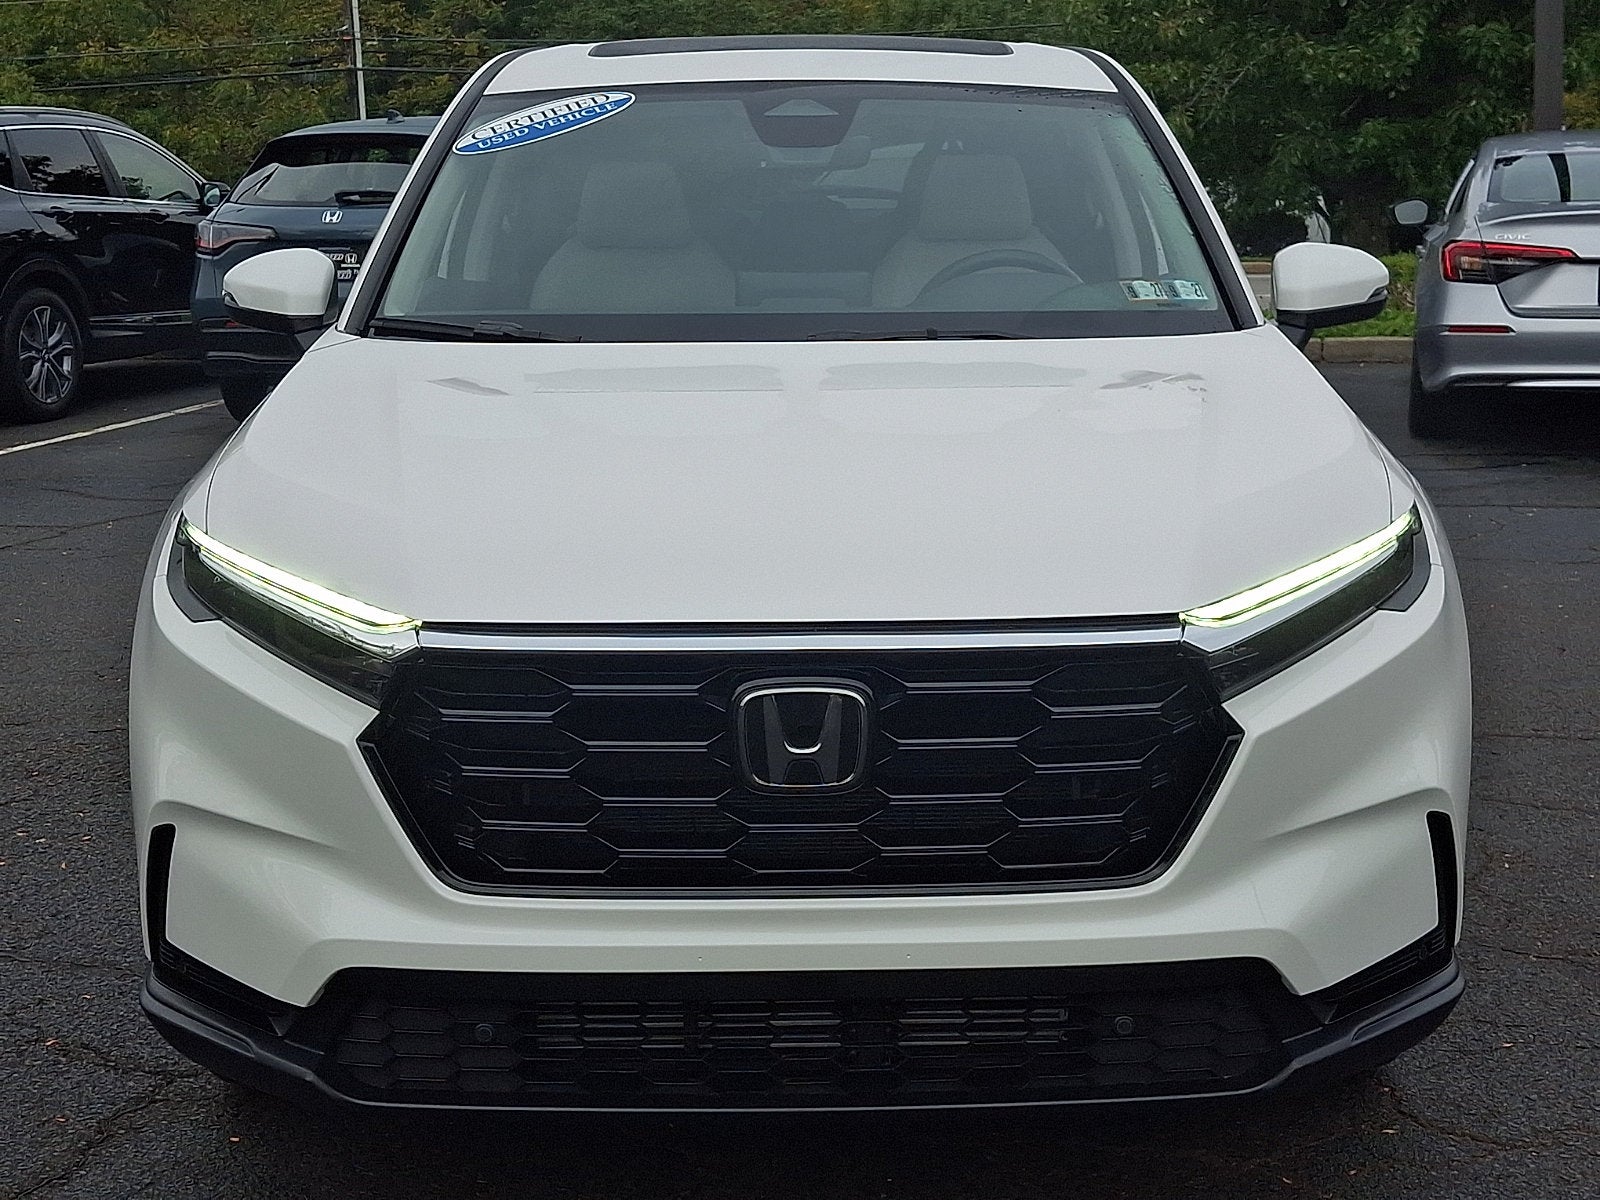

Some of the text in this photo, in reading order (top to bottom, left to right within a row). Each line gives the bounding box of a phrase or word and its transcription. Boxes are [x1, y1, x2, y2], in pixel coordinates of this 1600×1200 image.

[472, 93, 611, 141] CERTIFIED
[477, 101, 618, 149] USED VEHICLE
